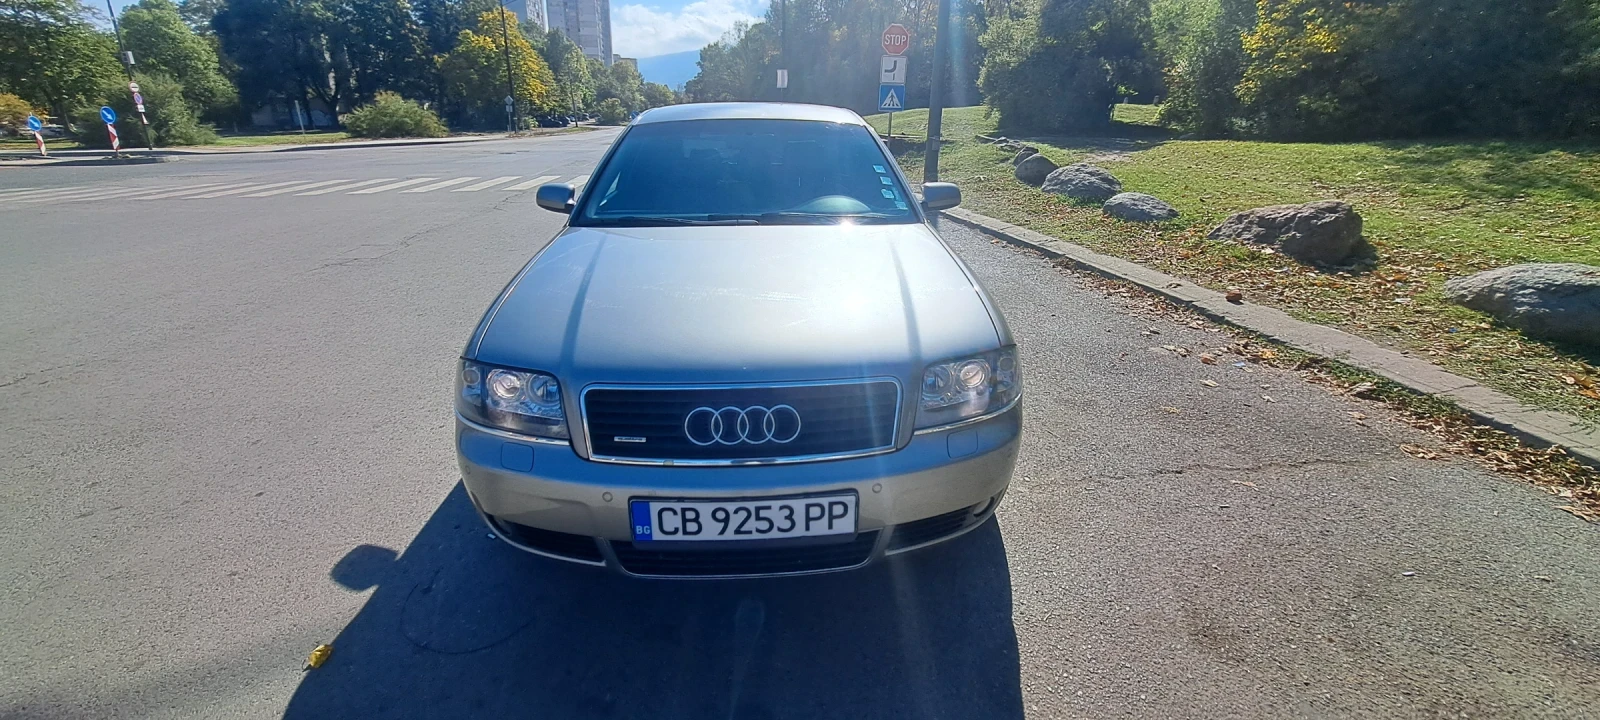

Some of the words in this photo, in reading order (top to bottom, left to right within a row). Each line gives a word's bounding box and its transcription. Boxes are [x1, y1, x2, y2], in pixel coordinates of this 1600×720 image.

[884, 34, 907, 46] STOP
[657, 507, 703, 536] CB
[710, 504, 796, 536] 9253
[804, 501, 849, 532] PP
[635, 525, 651, 535] BG
